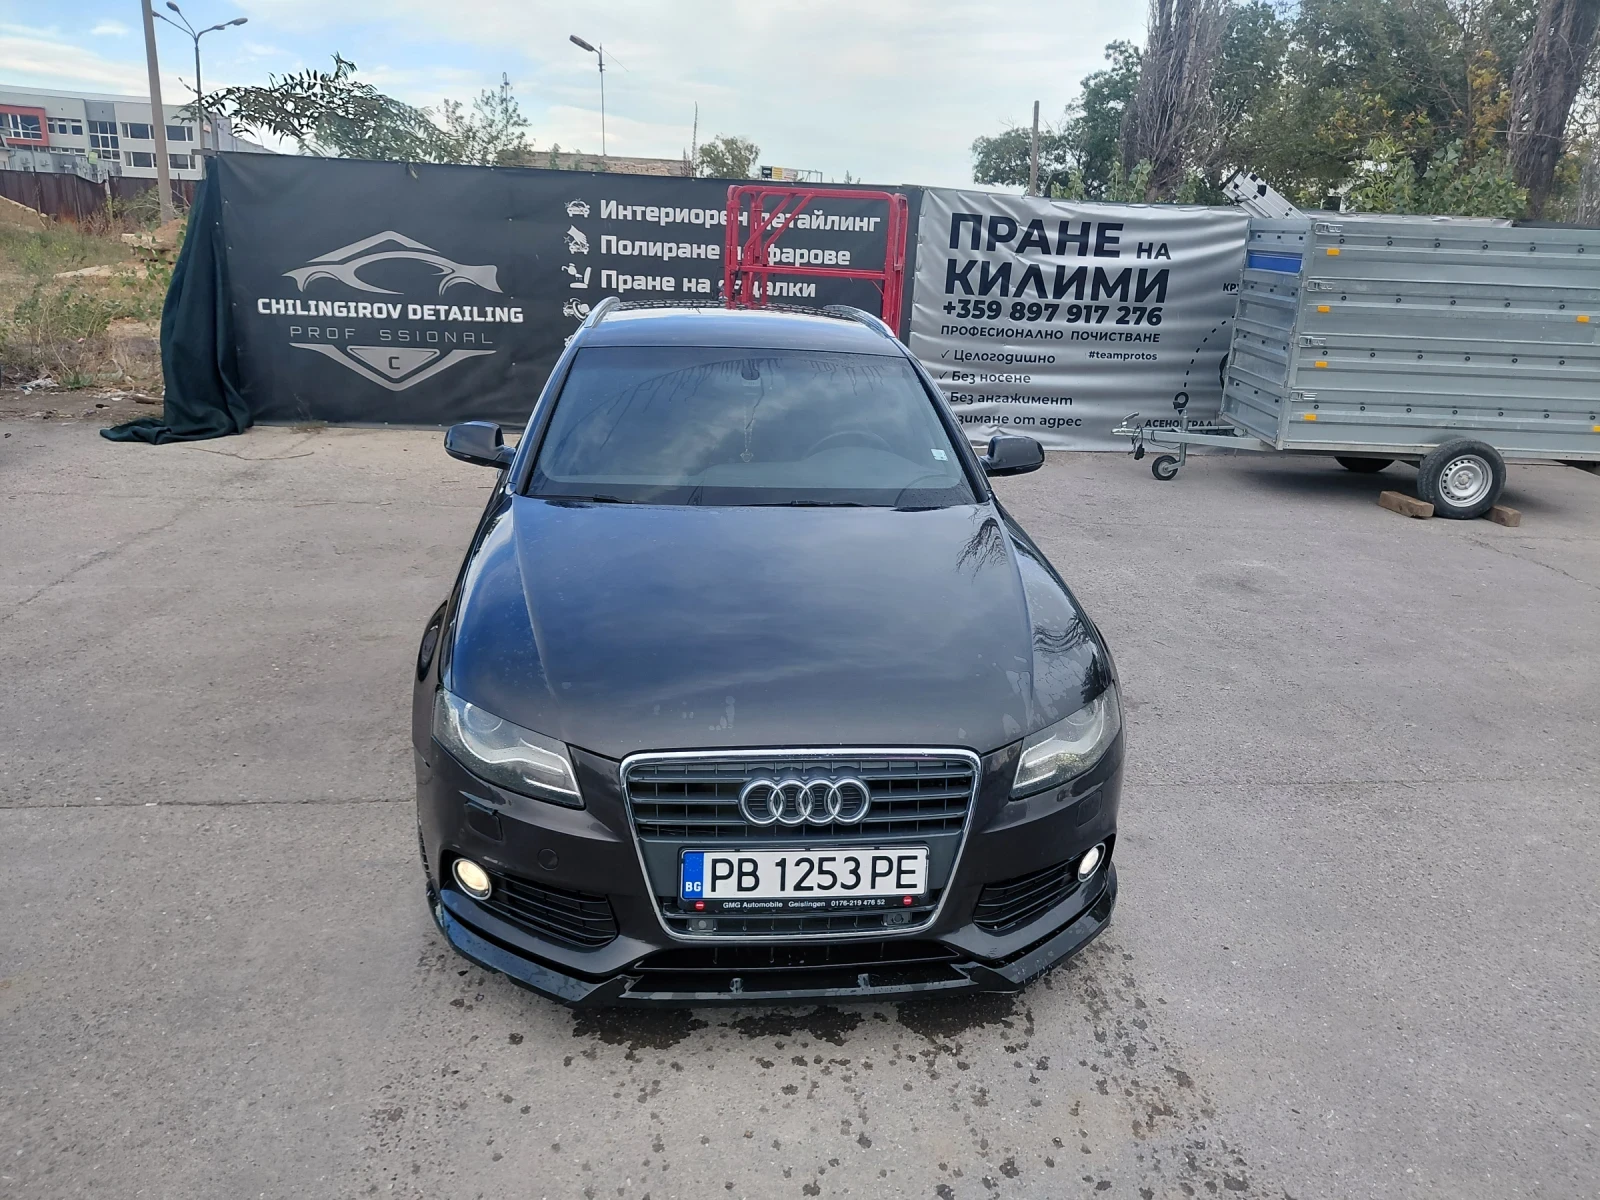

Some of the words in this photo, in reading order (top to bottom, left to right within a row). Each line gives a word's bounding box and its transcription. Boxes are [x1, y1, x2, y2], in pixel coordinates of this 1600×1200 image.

[949, 212, 1124, 258] ПРАНЕ
[1136, 242, 1172, 260] НА
[600, 235, 720, 261] Полиране
[768, 243, 851, 267] фарове
[600, 270, 675, 292] Пране
[683, 276, 711, 293] на
[944, 258, 1170, 304] КИЛИМИ
[257, 298, 402, 320] CHILINGIROV
[407, 304, 524, 323] DETAILING
[943, 298, 1002, 320] +359
[1009, 301, 1060, 322] 897
[1066, 303, 1109, 324] 917
[1115, 305, 1163, 326] 276
[940, 325, 1064, 340] ПРОФЕСИОНАЛНО
[1070, 330, 1161, 343] ПОЧИСТВАНЕ
[953, 349, 1056, 365] Целогодишно
[1088, 350, 1158, 362] #teamprotos
[951, 371, 976, 384] Без
[979, 372, 1031, 384] носене
[950, 391, 974, 405] Без
[977, 393, 1073, 406] ангажимент
[956, 413, 1009, 425] зимане
[1013, 415, 1036, 426] от
[1039, 416, 1082, 428] адрес
[710, 857, 760, 893] PB
[774, 856, 862, 892] 1253
[870, 855, 918, 889] PE
[685, 881, 702, 892] BG
[722, 901, 741, 909] GMG
[788, 900, 826, 909] Geislingen
[830, 899, 862, 907] 0176-219
[876, 898, 886, 906] 52
